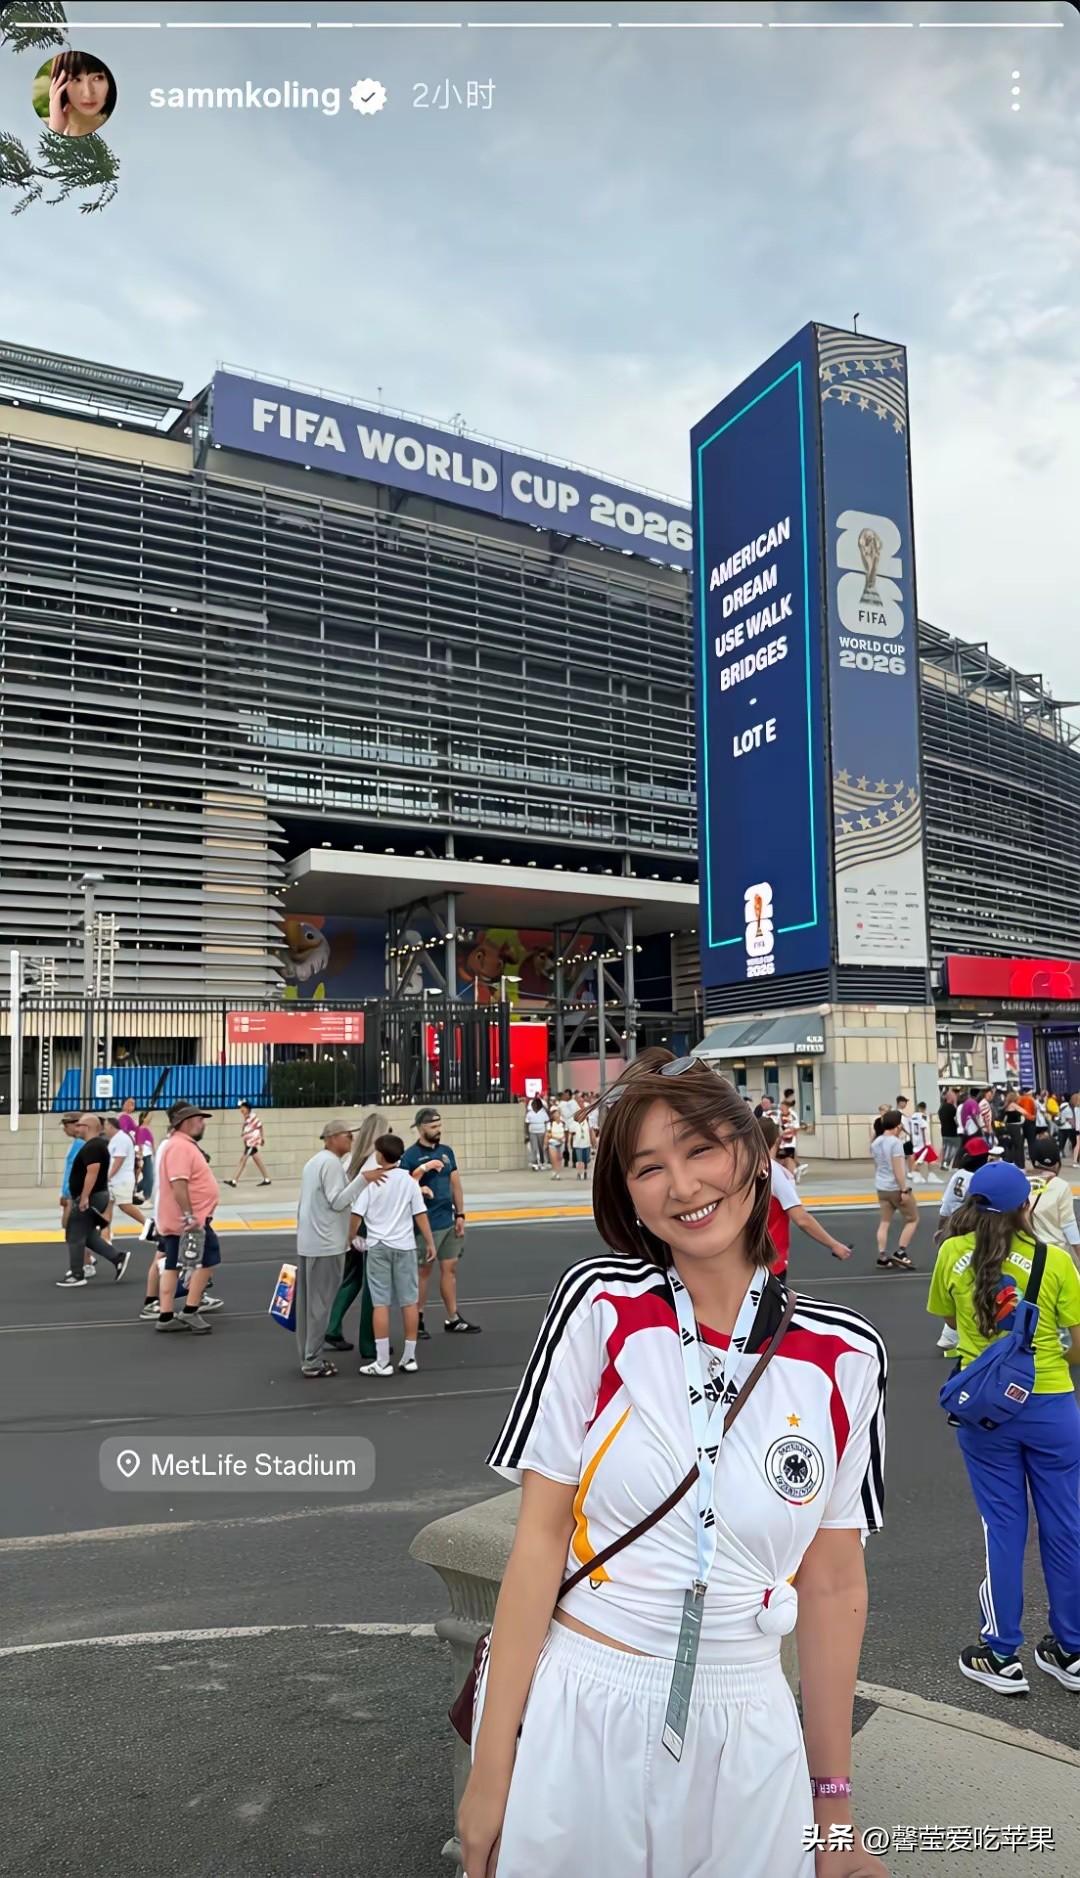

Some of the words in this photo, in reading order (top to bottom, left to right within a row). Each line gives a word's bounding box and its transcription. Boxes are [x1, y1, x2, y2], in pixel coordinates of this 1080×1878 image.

[252, 397, 346, 454] FIFA
[356, 425, 498, 493] WORLD
[510, 470, 580, 514] CUP
[590, 494, 692, 550] 2026
[709, 516, 791, 592] AMERICAN
[722, 564, 777, 619] DREAM
[858, 609, 887, 627] FIFA
[715, 623, 745, 658] USE
[746, 593, 793, 643] WALK
[839, 636, 881, 653] WORLD
[883, 641, 906, 656] CUP
[720, 635, 787, 692] BRIDGES
[839, 650, 906, 676] 2026
[819, 1783, 837, 1794] GER
